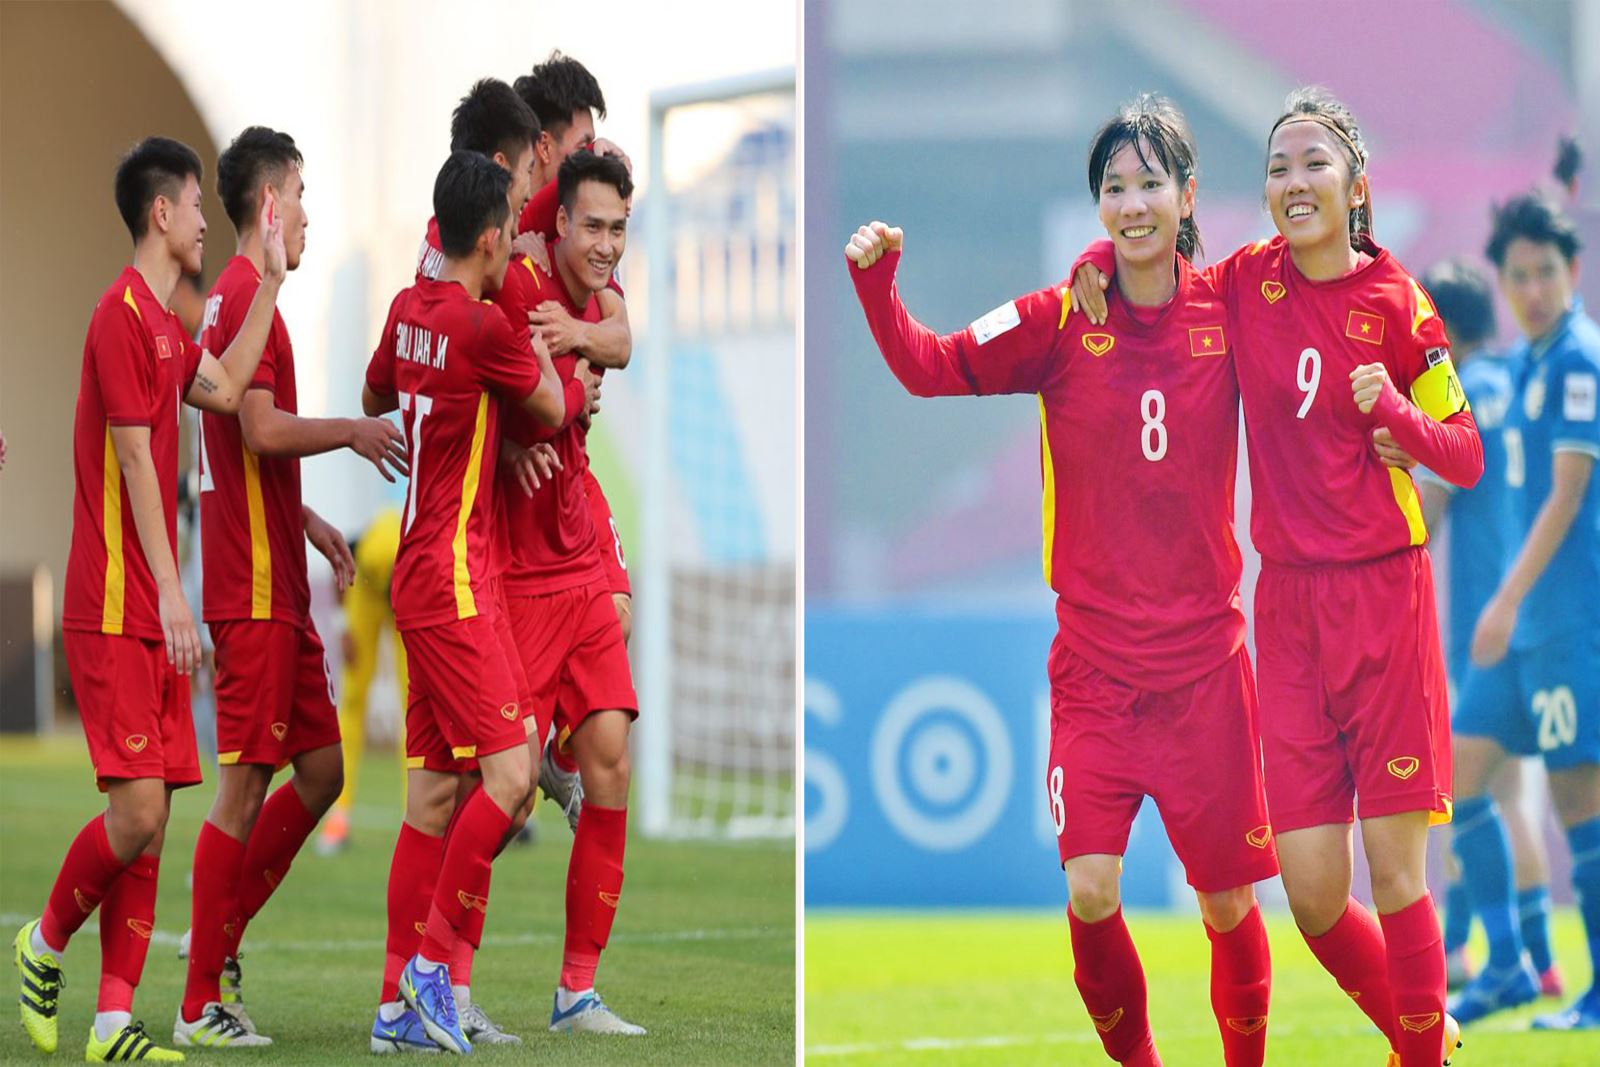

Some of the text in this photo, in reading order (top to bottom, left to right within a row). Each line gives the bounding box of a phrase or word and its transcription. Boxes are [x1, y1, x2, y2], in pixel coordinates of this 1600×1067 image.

[1297, 347, 1322, 420] 9
[1140, 389, 1168, 462] 8
[1531, 686, 1578, 751] 20
[1050, 765, 1066, 837] 8
